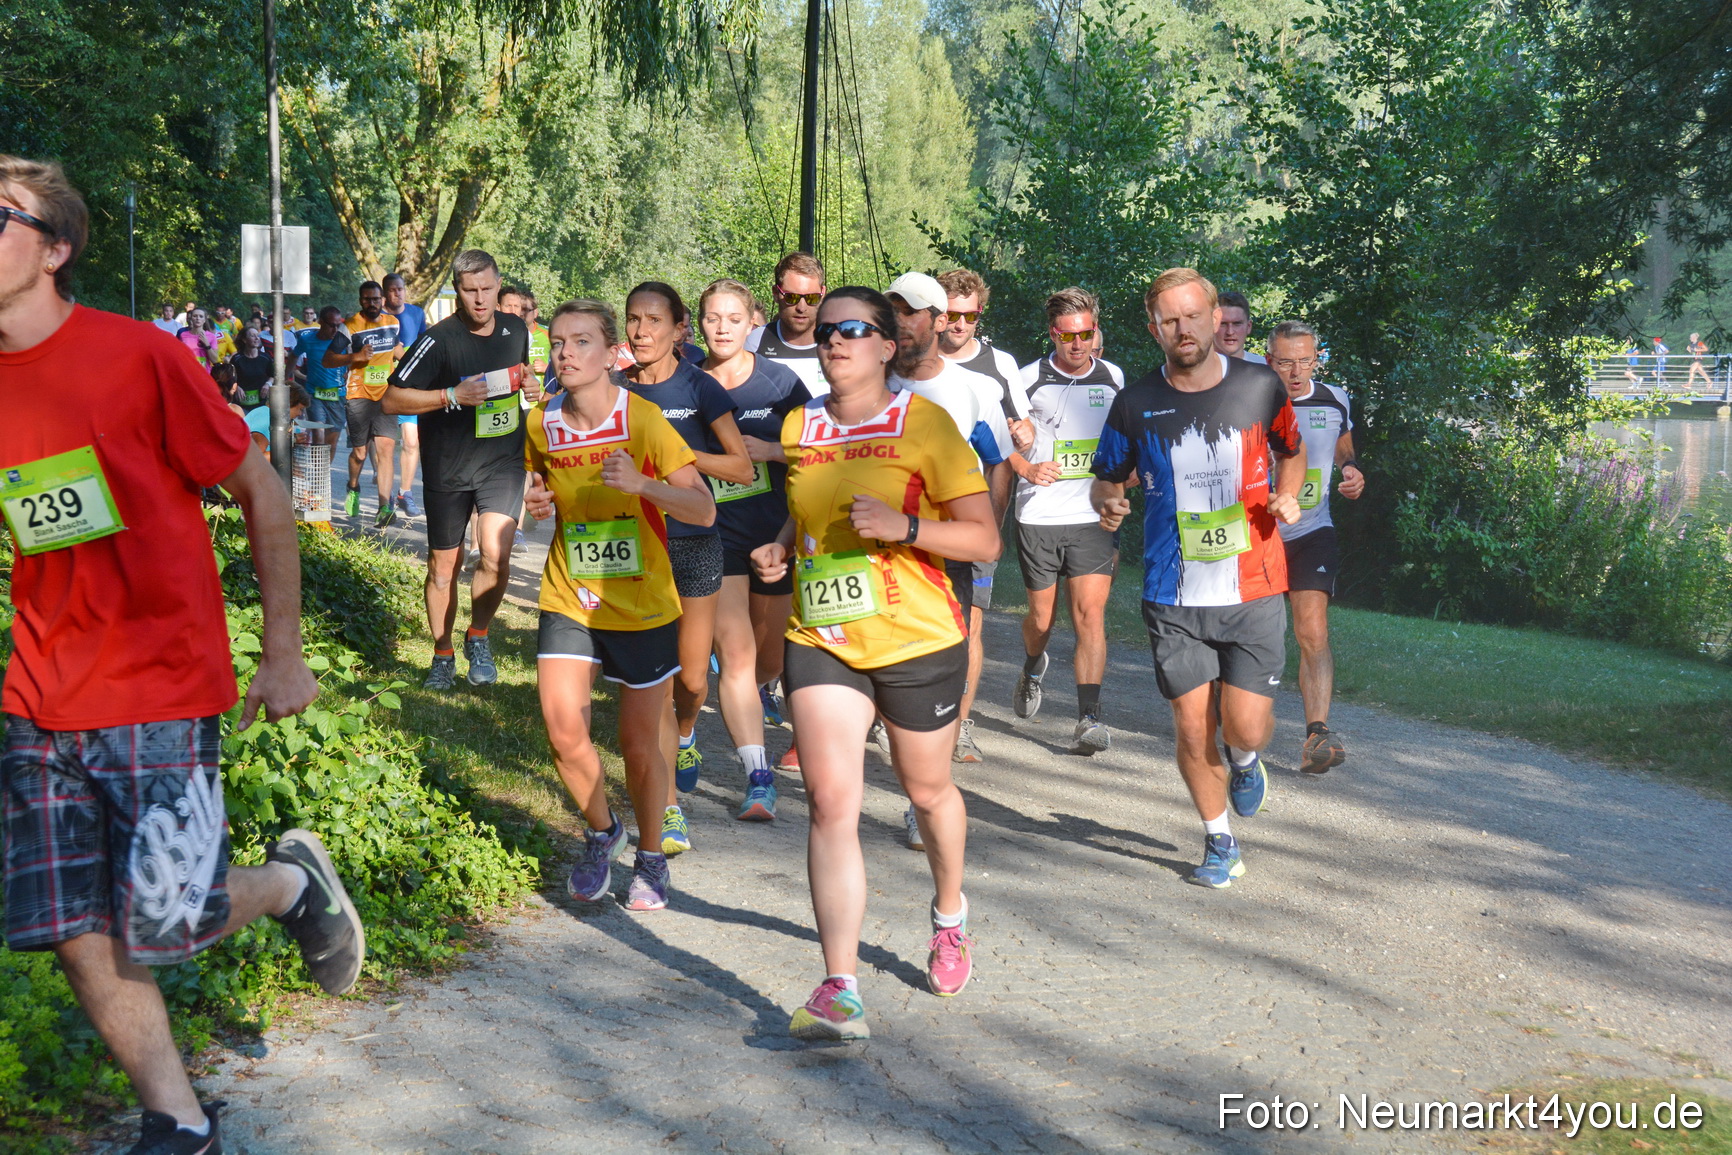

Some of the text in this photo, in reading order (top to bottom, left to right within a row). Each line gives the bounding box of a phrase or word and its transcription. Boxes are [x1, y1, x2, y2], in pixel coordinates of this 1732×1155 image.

[370, 371, 385, 380] 562
[492, 411, 509, 426] 53
[550, 447, 635, 469] MAX BÖL
[797, 442, 901, 469] MAX BÖGL
[1183, 468, 1229, 481] AUTOHAUS
[1189, 478, 1223, 490] MÜLLER
[21, 487, 83, 528] 239
[56, 518, 89, 533] Sascha
[1201, 528, 1227, 547] 48
[573, 540, 631, 563] 1346
[804, 575, 863, 606] 1218
[836, 601, 864, 610] Marketa
